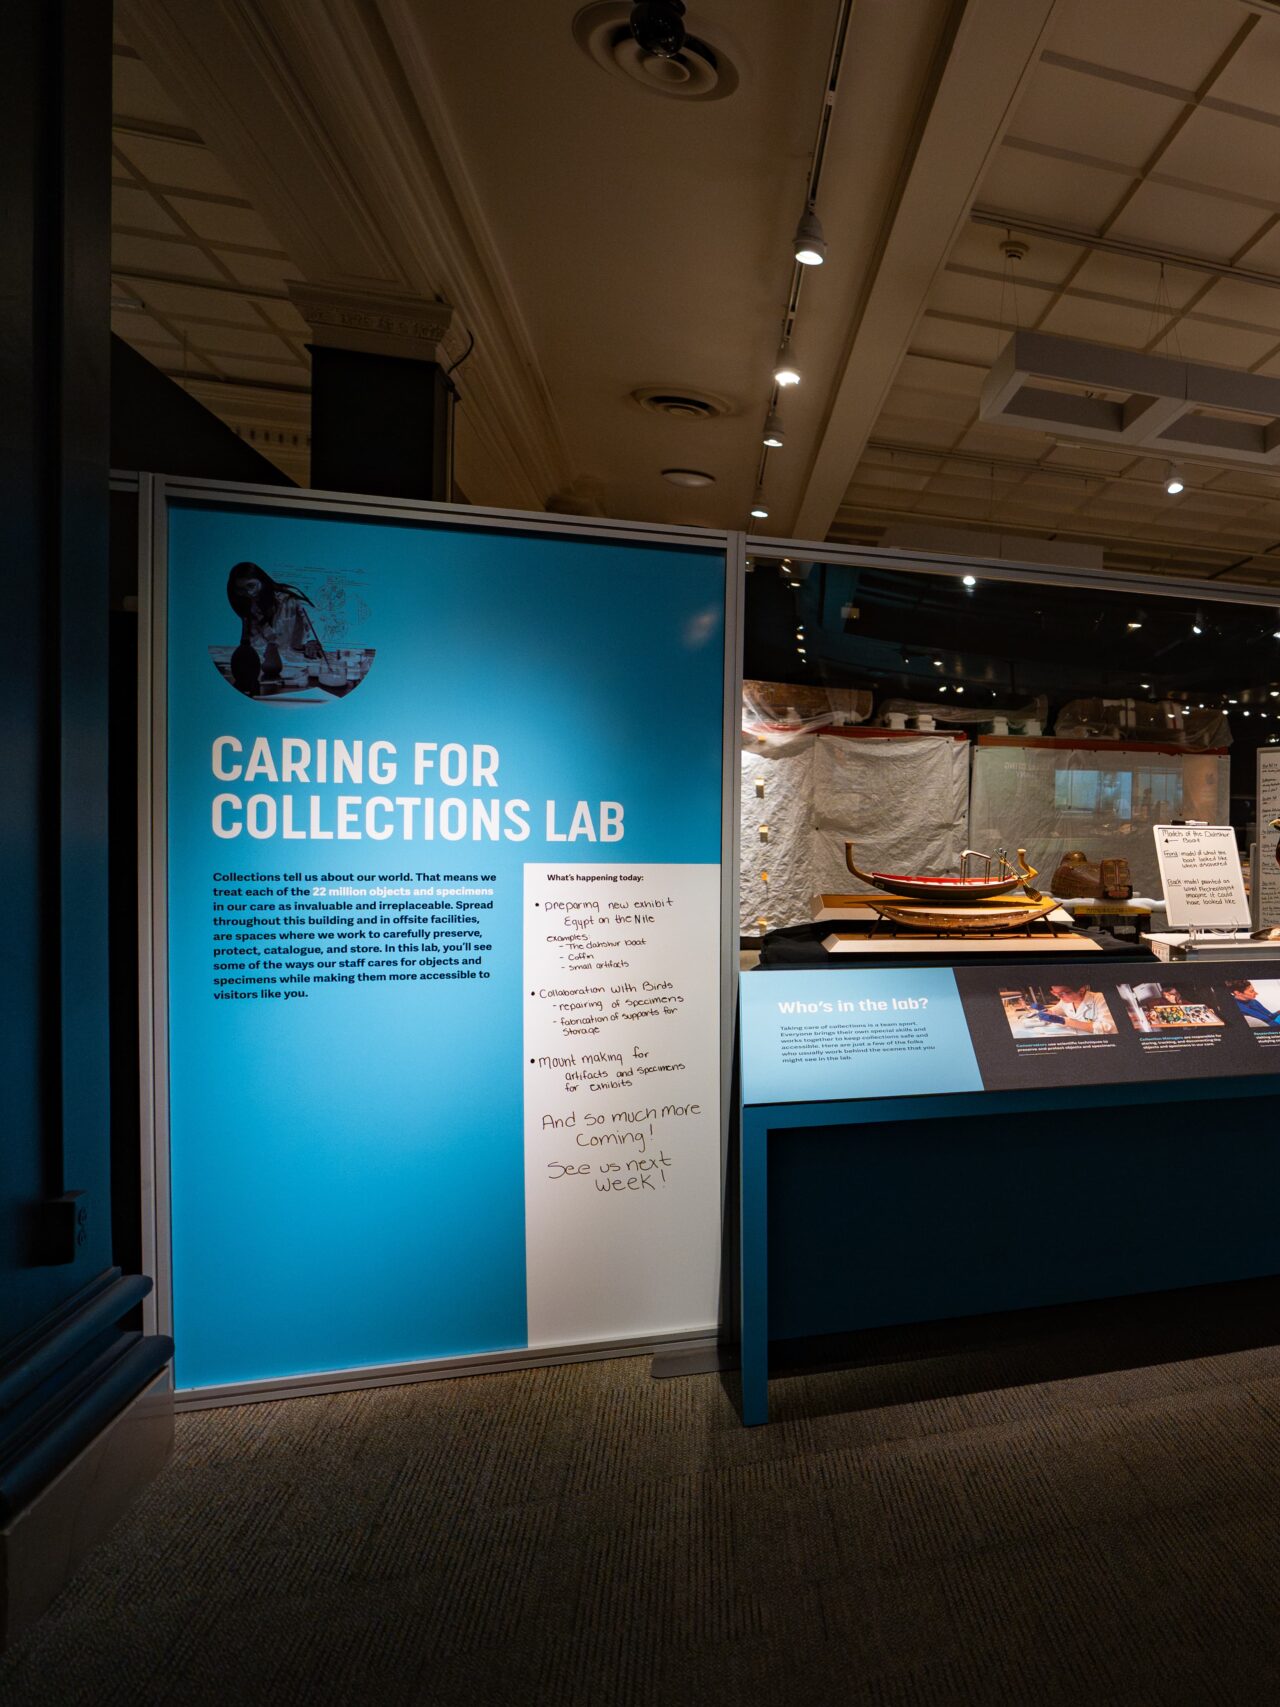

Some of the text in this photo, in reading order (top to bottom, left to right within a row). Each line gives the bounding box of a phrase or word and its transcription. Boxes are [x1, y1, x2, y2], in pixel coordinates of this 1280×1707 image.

[212, 735, 499, 786] CARING FOR
[211, 793, 624, 842] COLLECTIONS LAB
[213, 872, 280, 881] Collections
[283, 872, 302, 881] tell
[320, 872, 354, 881] about
[378, 872, 413, 881] world.
[415, 872, 441, 881] That
[576, 874, 618, 882] happening
[619, 874, 643, 882] today:
[213, 886, 494, 898] treat each of the 22 million objects and specimens
[213, 902, 224, 911] in
[294, 901, 353, 910] invaluable
[355, 901, 376, 910] and
[379, 900, 453, 911] irreplaceable.
[455, 900, 493, 911] Spread
[634, 897, 674, 908] exhibit
[213, 914, 479, 928] throughout this building and in offsite facilities,
[564, 916, 594, 930] Egypt
[615, 915, 632, 924] the
[213, 933, 232, 941] are
[235, 933, 276, 942] spaces
[279, 930, 315, 939] where
[337, 929, 366, 939] work
[368, 930, 380, 938] to
[383, 929, 431, 940] carefully
[433, 930, 482, 940] preserve,
[213, 946, 261, 958] protect,
[263, 945, 323, 956] catalogue,
[326, 944, 347, 953] and
[350, 944, 382, 953] store.
[385, 944, 395, 952] In
[398, 943, 419, 952] this
[421, 943, 440, 953] lab,
[442, 942, 471, 953] you'll
[248, 960, 260, 969] of
[263, 960, 282, 969] the
[285, 961, 314, 970] ways
[338, 958, 365, 967] staff
[400, 957, 416, 966] for
[419, 956, 459, 968] objects
[461, 956, 481, 965] and
[596, 960, 629, 969] artifacts
[213, 975, 277, 987] specimens
[279, 974, 310, 983] while
[313, 973, 355, 984] making
[357, 972, 386, 982] them
[419, 970, 476, 980] accessible
[478, 970, 490, 978] to
[213, 989, 308, 1000] visitors like you.
[539, 986, 605, 998] Collaboration
[642, 981, 673, 992] Birds
[559, 1001, 603, 1011] repairing
[611, 1000, 620, 1008] of
[778, 997, 928, 1013] Who's in the lab?
[560, 1013, 609, 1026] fabrication
[663, 1006, 678, 1015] for
[582, 1052, 623, 1066] making
[632, 1046, 649, 1059] for
[616, 1067, 633, 1078] and
[565, 1083, 579, 1092] for
[542, 1111, 576, 1130] And
[612, 1108, 657, 1123] much
[547, 1151, 672, 1179] See us next
